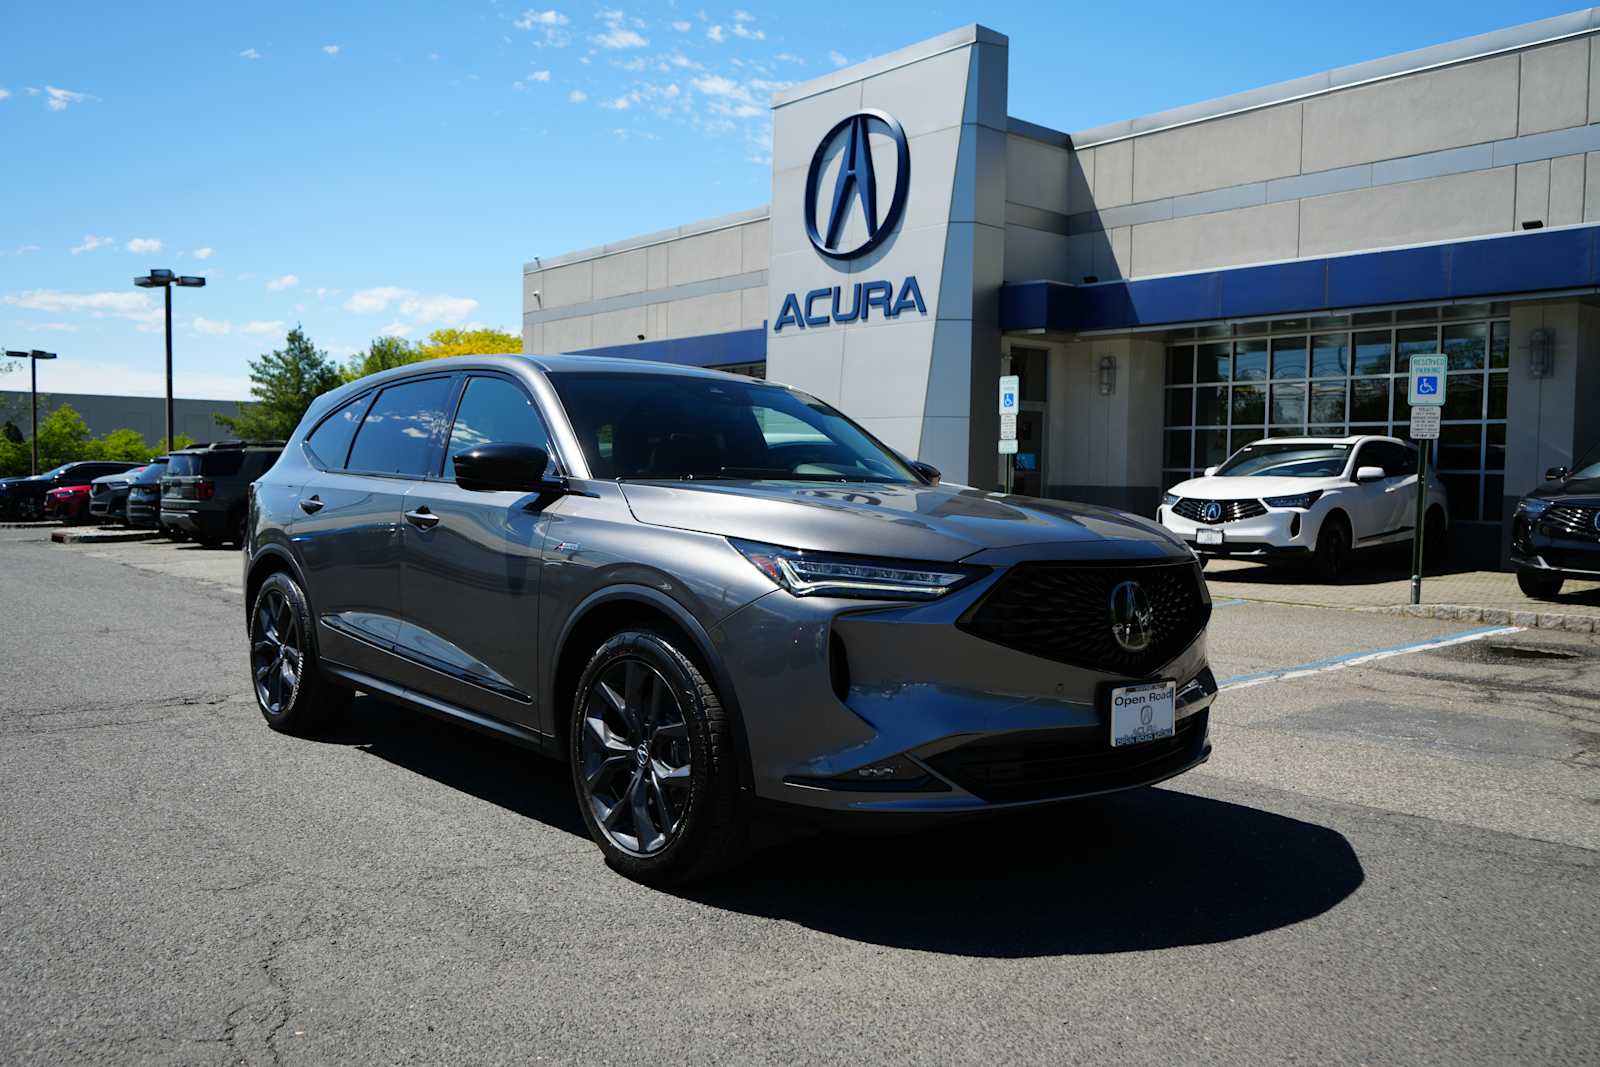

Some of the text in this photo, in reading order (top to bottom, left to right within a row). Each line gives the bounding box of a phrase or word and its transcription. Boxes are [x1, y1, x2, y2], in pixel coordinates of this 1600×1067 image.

[774, 275, 927, 331] ACURA
[1115, 691, 1172, 708] Open Road
